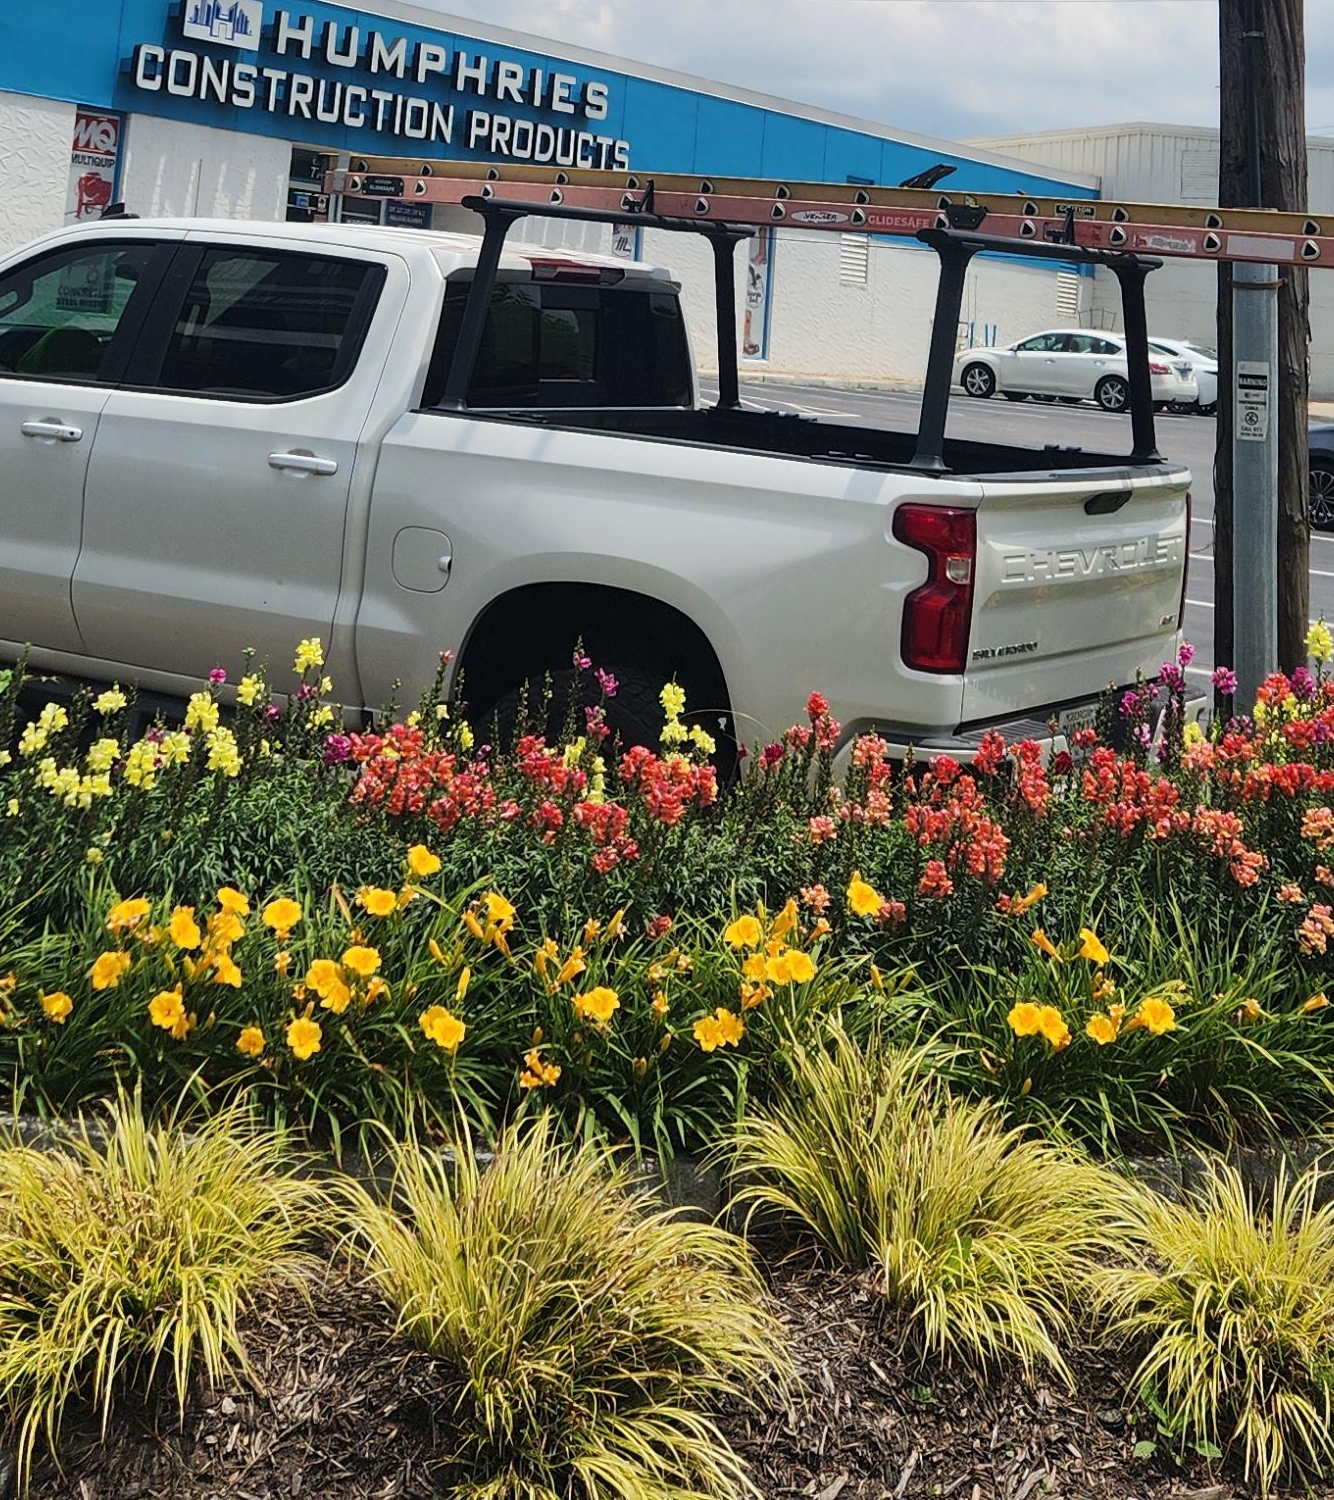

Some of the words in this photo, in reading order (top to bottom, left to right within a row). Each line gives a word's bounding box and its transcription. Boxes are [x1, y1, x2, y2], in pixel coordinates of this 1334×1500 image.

[275, 10, 609, 120] HUMPHRIES
[135, 43, 454, 144] CONSTRUCTION
[468, 110, 631, 171] PRODUCTS
[867, 214, 930, 229] GLIDESAFE
[1000, 535, 1183, 584] CHEVROLET
